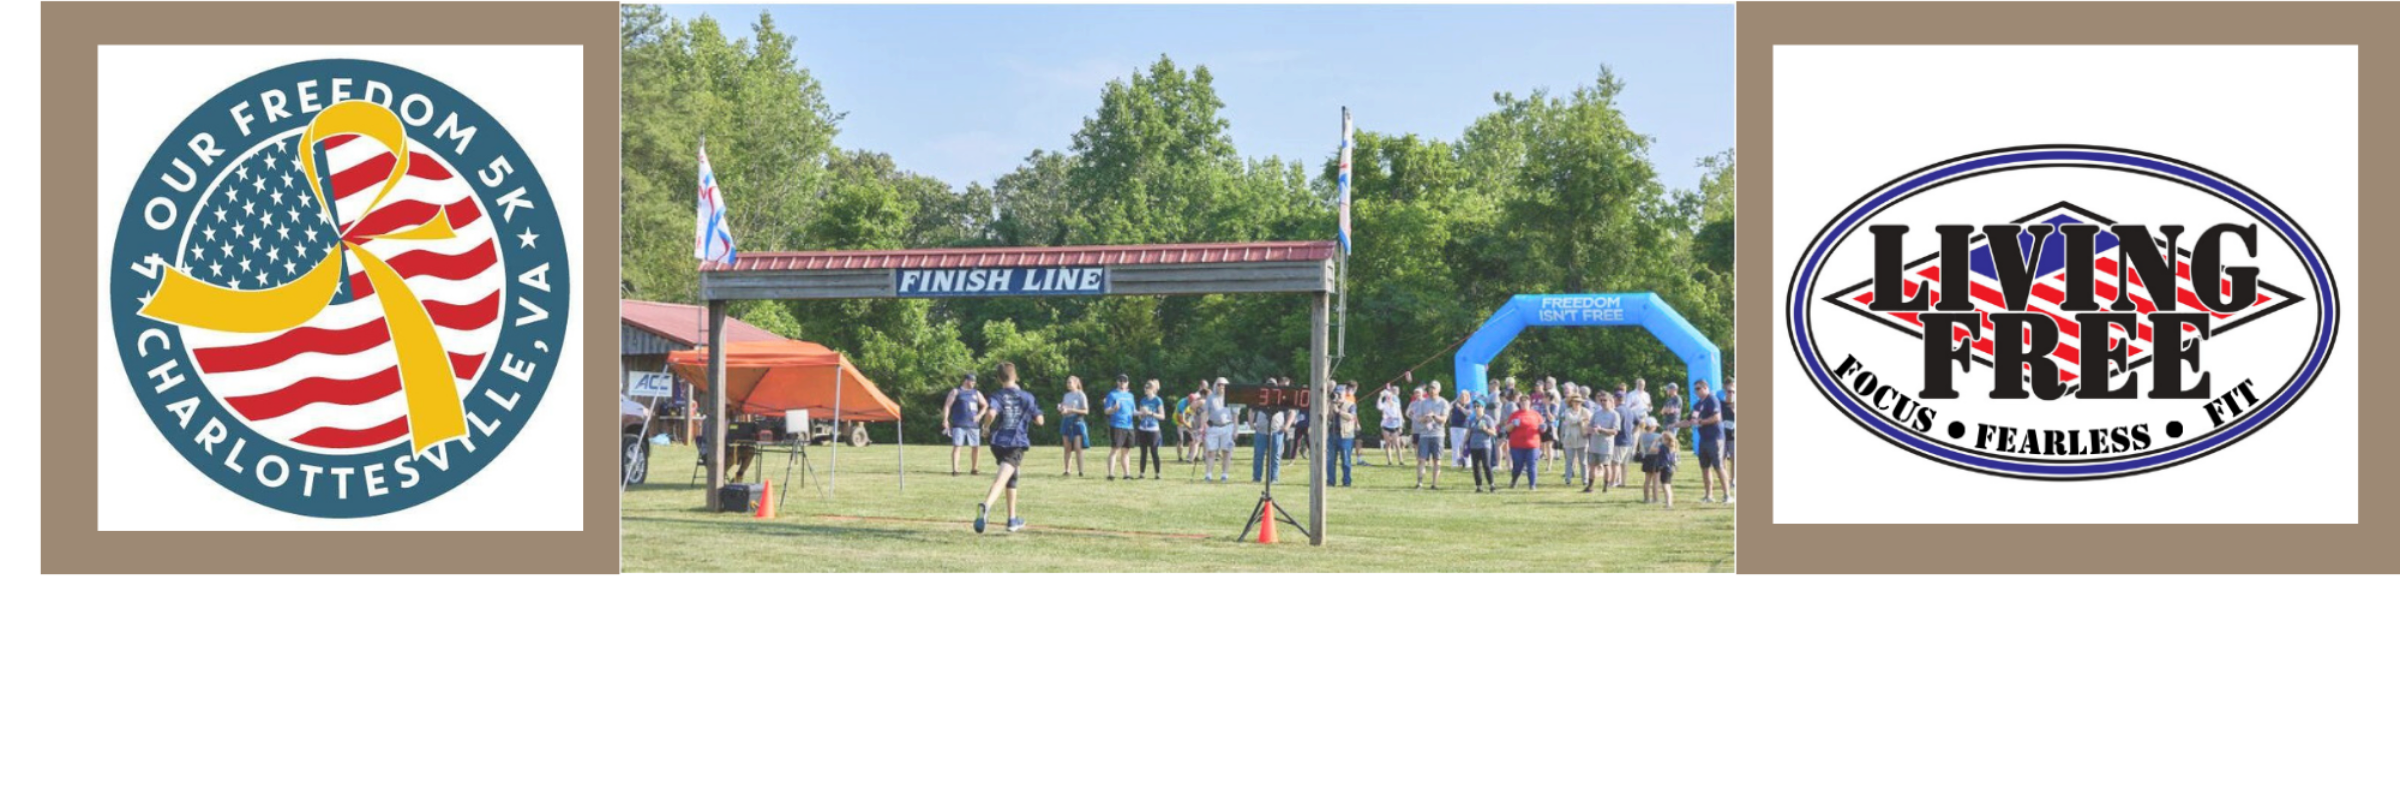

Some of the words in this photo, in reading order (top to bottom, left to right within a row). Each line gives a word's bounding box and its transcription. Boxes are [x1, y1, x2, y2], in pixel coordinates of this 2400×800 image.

[229, 77, 477, 154] FREEDOM
[144, 132, 226, 230] OUR
[478, 155, 534, 224] 5K
[131, 253, 163, 279] 4
[516, 263, 551, 326] VA
[898, 267, 1014, 293] FINISH
[1021, 266, 1103, 292] LINE
[1869, 223, 2260, 312] LIVING
[1538, 309, 1577, 322] ISN'T
[1582, 309, 1625, 322] FREE
[1541, 296, 1621, 309] FREEDOM
[1918, 312, 2212, 401] FREE
[1833, 354, 1938, 434] FOCUS
[1974, 422, 2152, 457] FEARLESS
[2202, 378, 2262, 429] FIT
